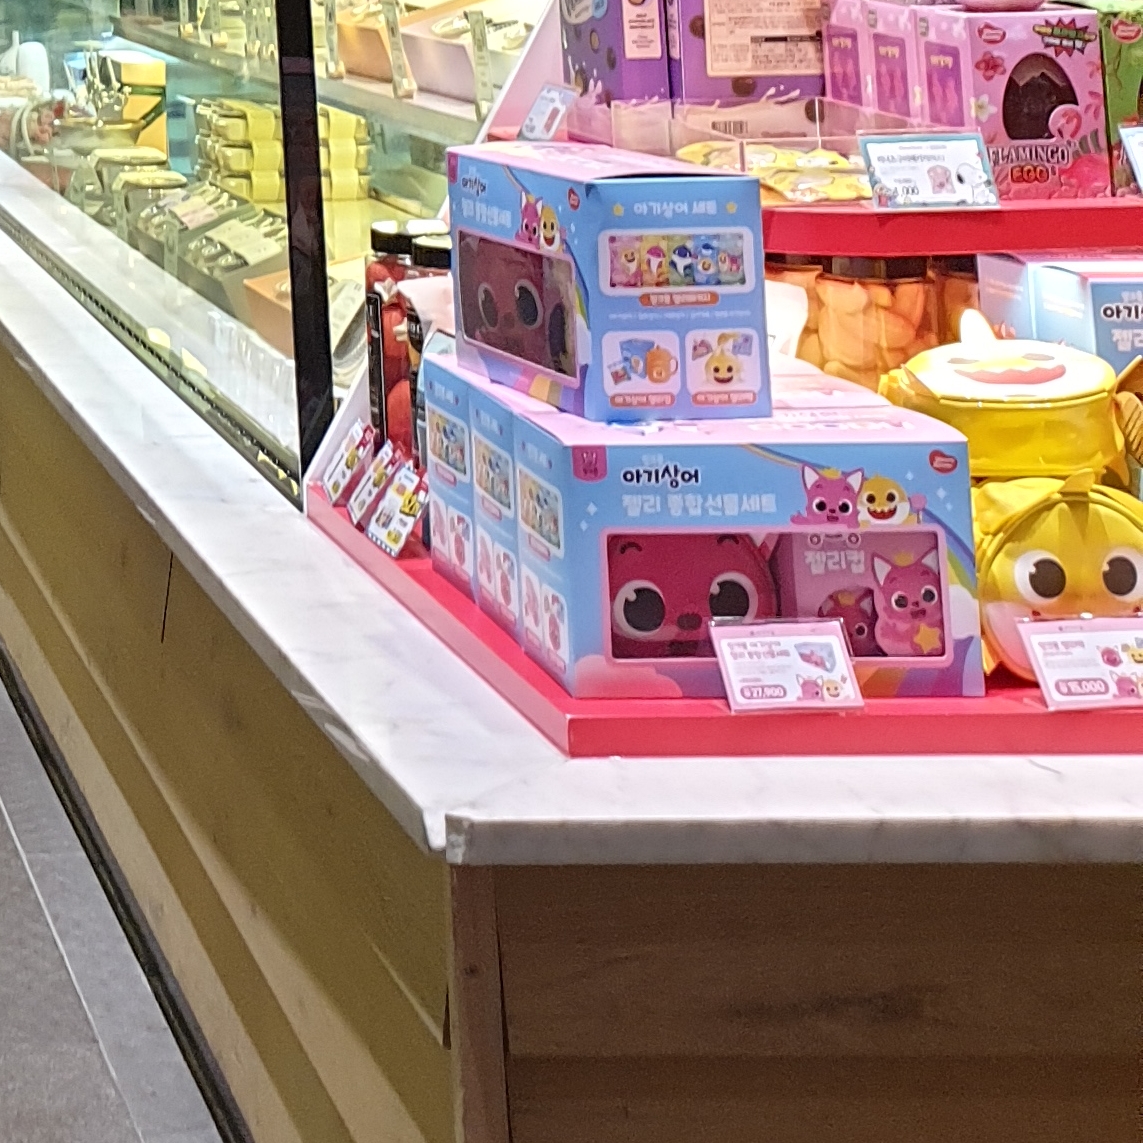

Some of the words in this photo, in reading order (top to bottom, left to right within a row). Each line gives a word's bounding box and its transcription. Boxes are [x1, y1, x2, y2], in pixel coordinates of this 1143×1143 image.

[987, 145, 1069, 166] FLAMINGO
[633, 200, 688, 219] 아기상어
[1101, 303, 1143, 322] 아기
[621, 463, 701, 490] 아기상어
